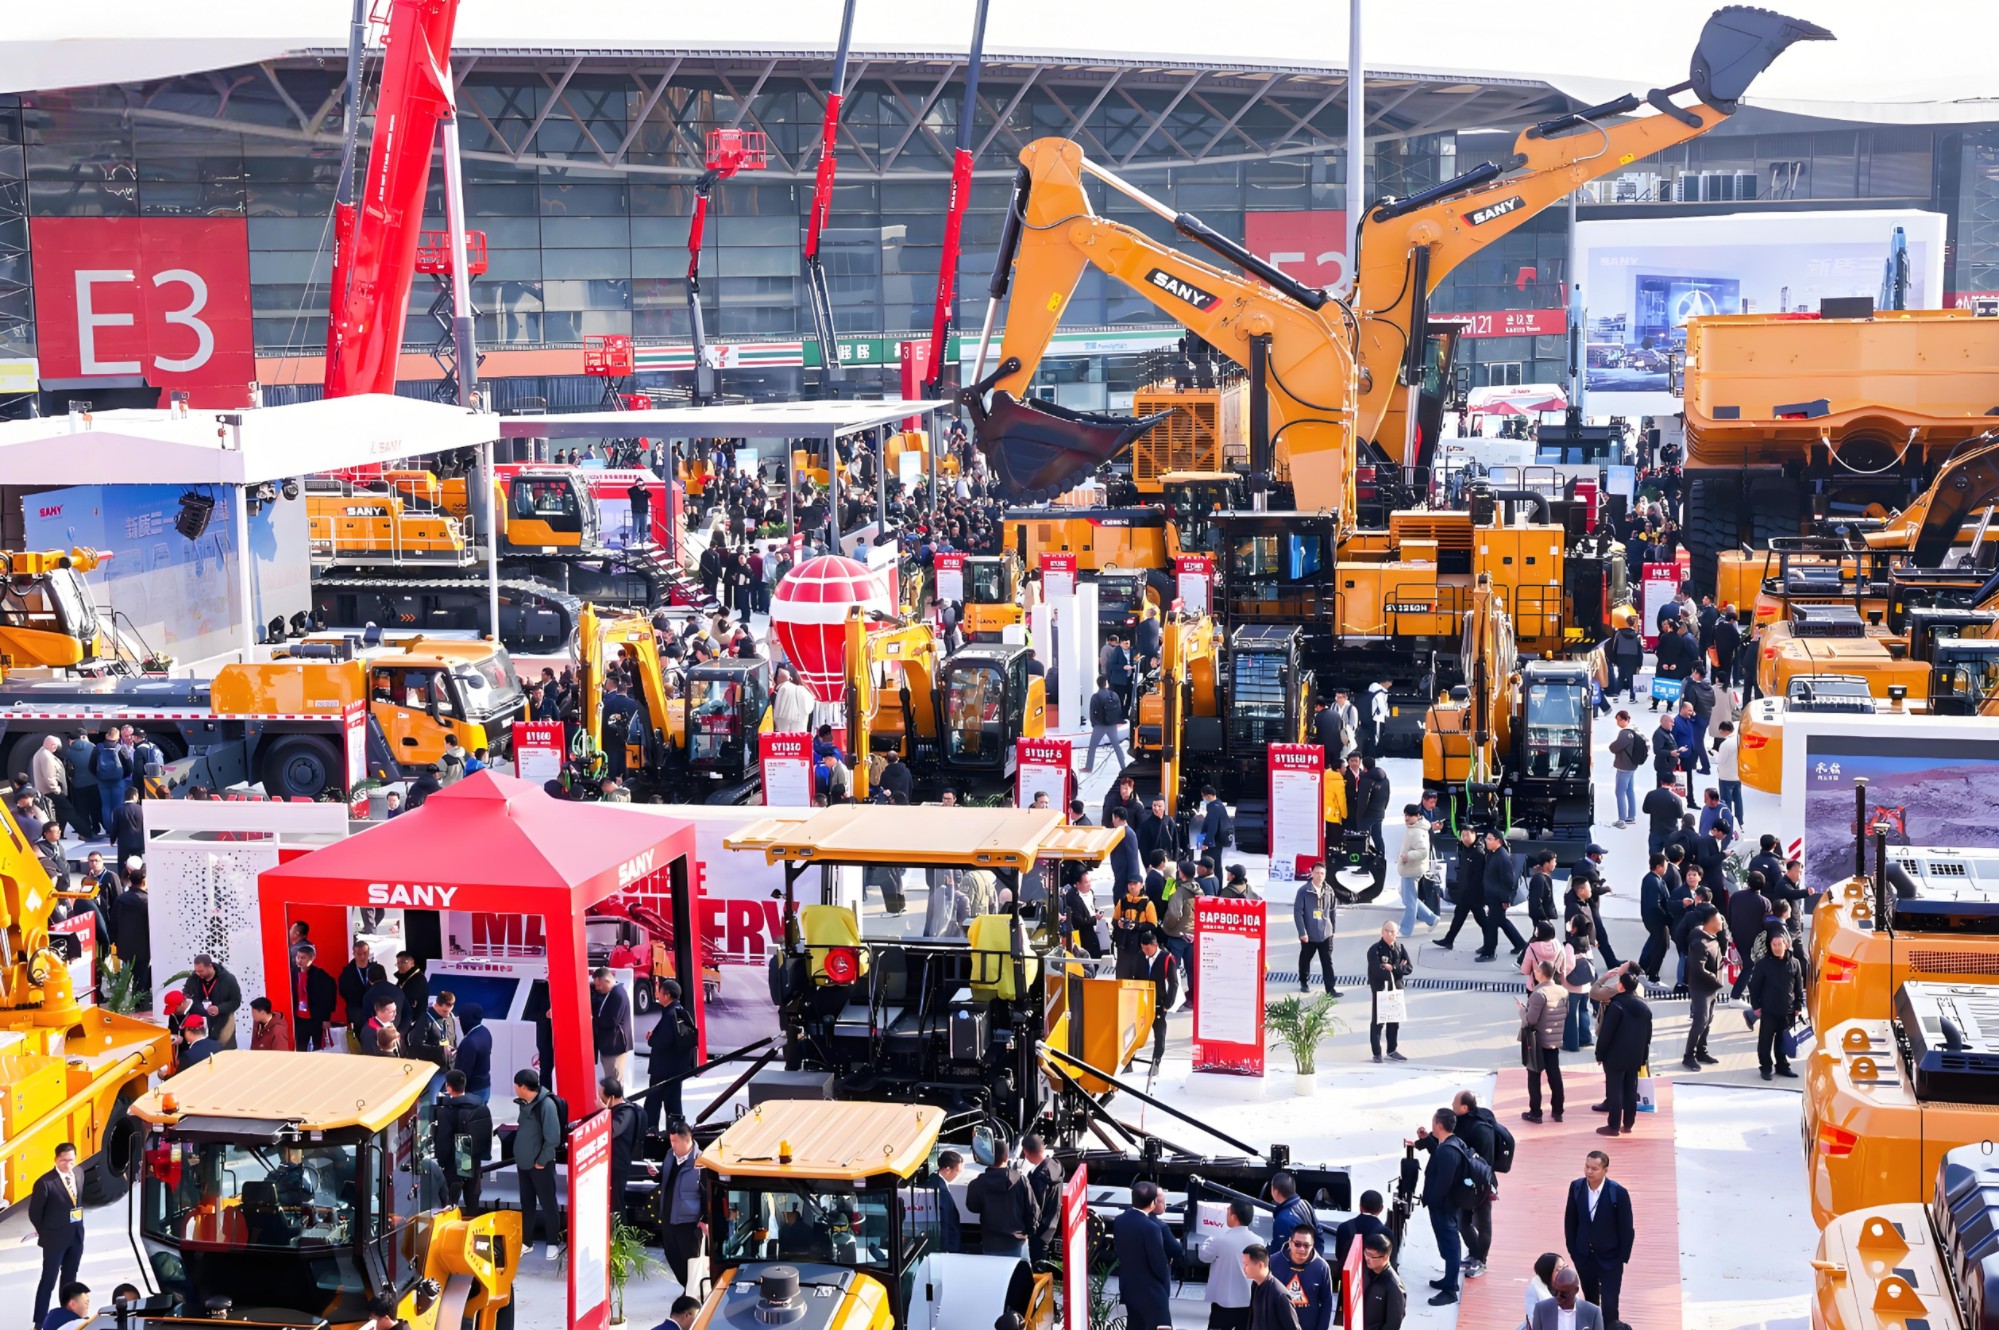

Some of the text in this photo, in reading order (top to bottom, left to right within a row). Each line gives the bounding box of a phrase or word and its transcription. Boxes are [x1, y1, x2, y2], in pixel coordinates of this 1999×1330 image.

[1473, 197, 1516, 225] SANY
[1600, 257, 1638, 266] SANY
[1153, 271, 1207, 306] SANY
[75, 269, 214, 374] E3
[39, 504, 64, 518] SANY
[346, 506, 385, 517] SANY
[618, 849, 655, 886] SANY
[368, 884, 458, 907] SANY
